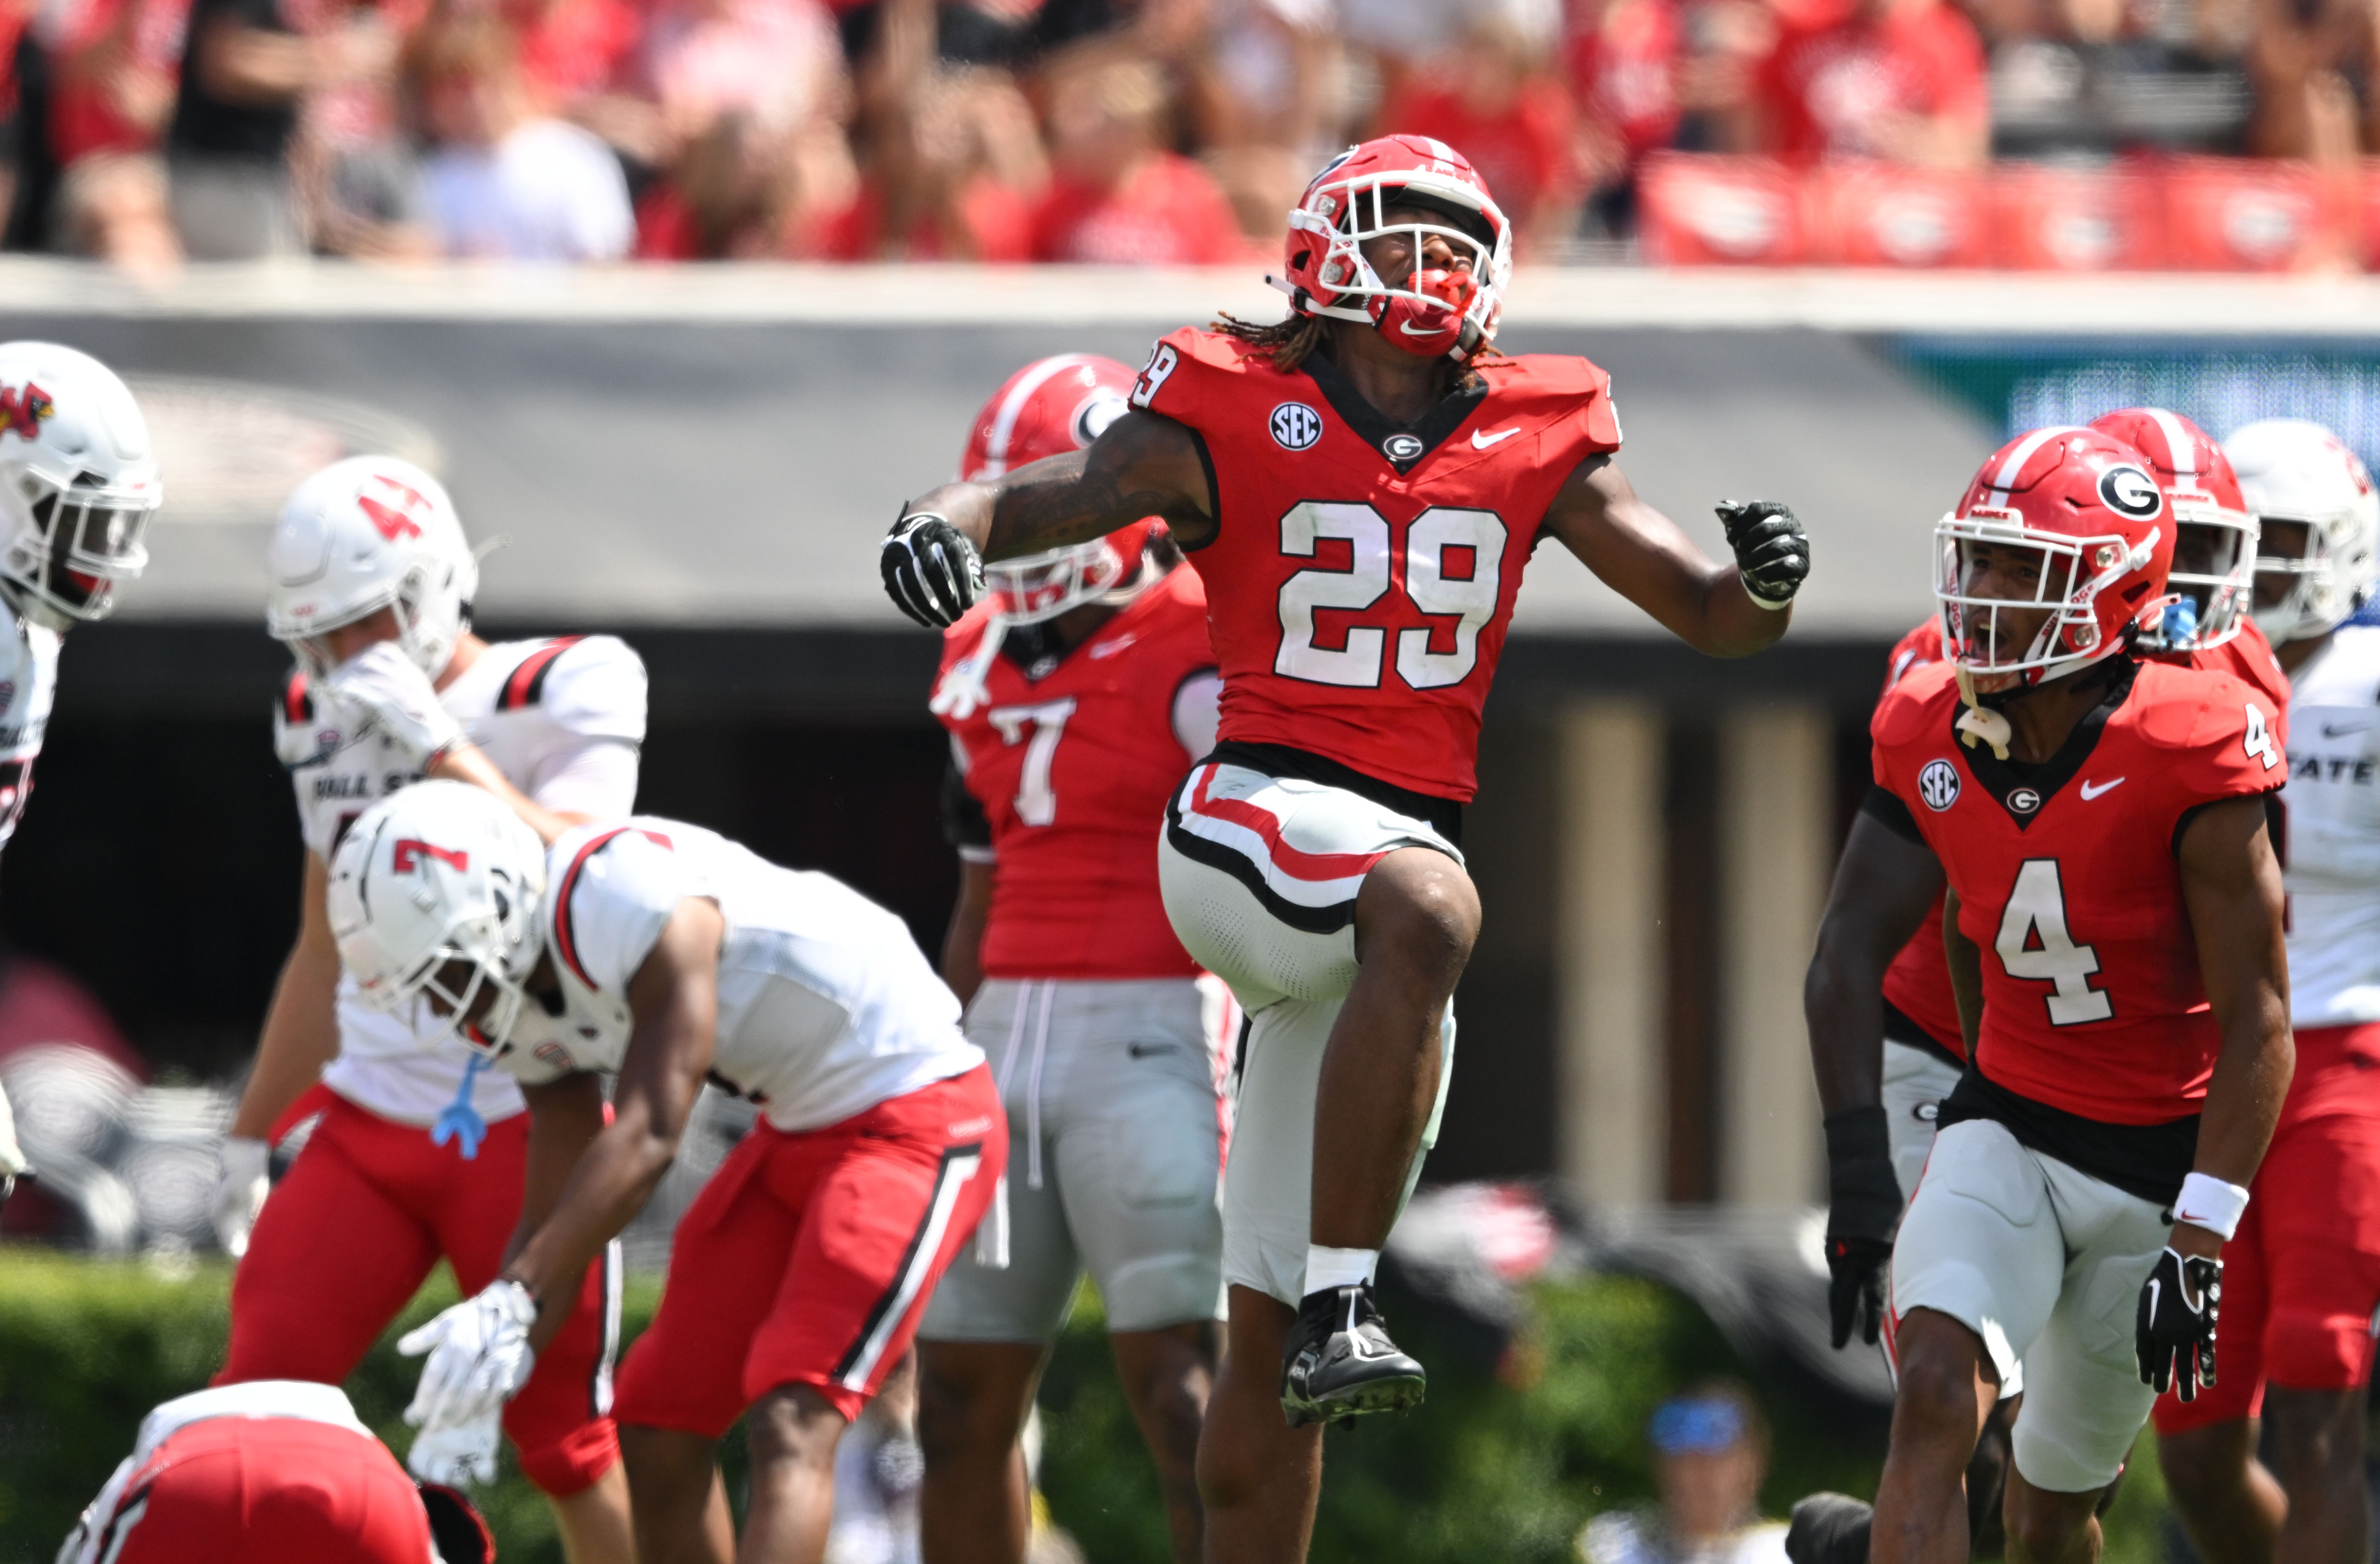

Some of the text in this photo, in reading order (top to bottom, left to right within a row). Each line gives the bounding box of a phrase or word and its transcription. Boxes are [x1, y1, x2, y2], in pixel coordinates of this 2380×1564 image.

[1273, 404, 1318, 448] SEC
[1392, 437, 1423, 455] G
[2113, 471, 2160, 509] G
[1273, 499, 1508, 690] 29
[2242, 702, 2279, 773] 4
[987, 696, 1078, 827] 7
[1922, 762, 1956, 808] SEC
[2014, 791, 2040, 810] G
[393, 837, 470, 874] 7
[1994, 858, 2115, 1026] 4
